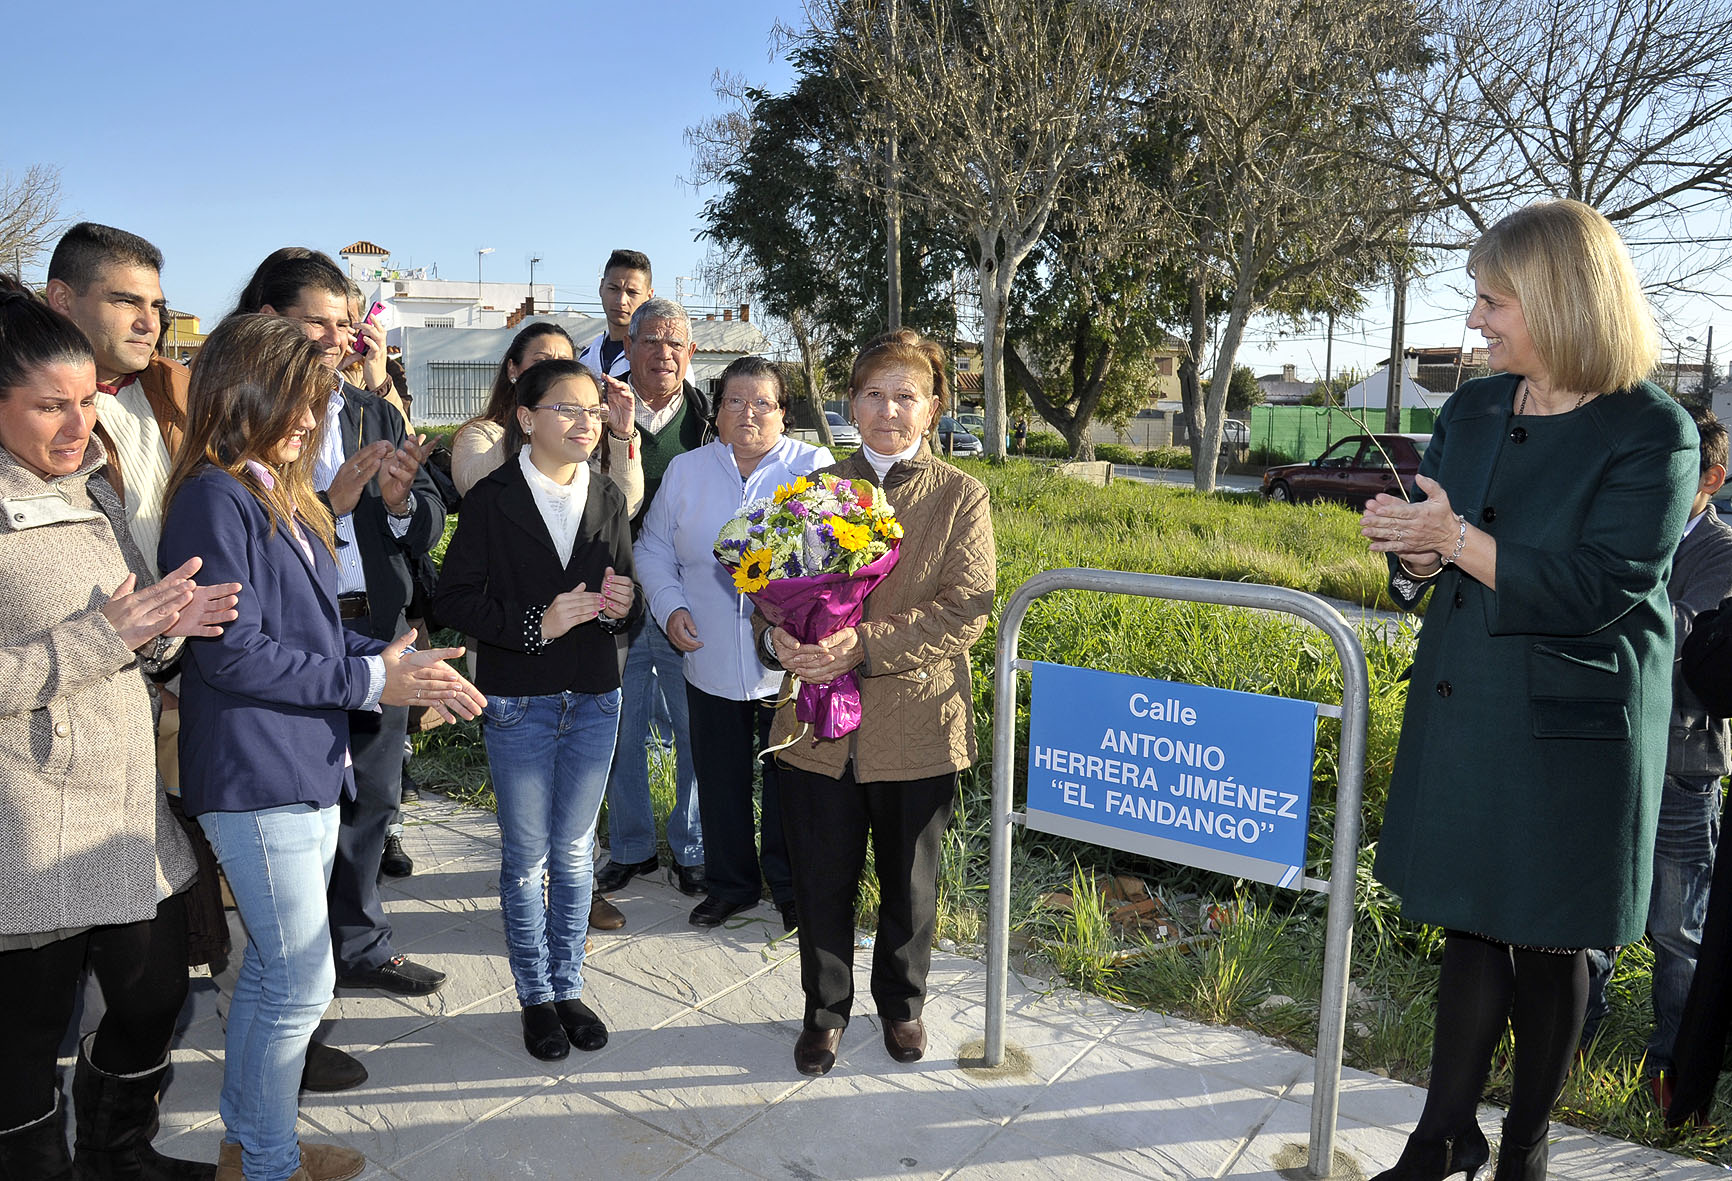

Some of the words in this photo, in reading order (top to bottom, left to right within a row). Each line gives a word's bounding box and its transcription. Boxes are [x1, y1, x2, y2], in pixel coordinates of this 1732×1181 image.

[1129, 693, 1197, 726] Calle
[1100, 728, 1225, 771] ANTONIO
[1034, 745, 1159, 792] HERRERA
[1169, 772, 1299, 819] JIMÉNEZ
